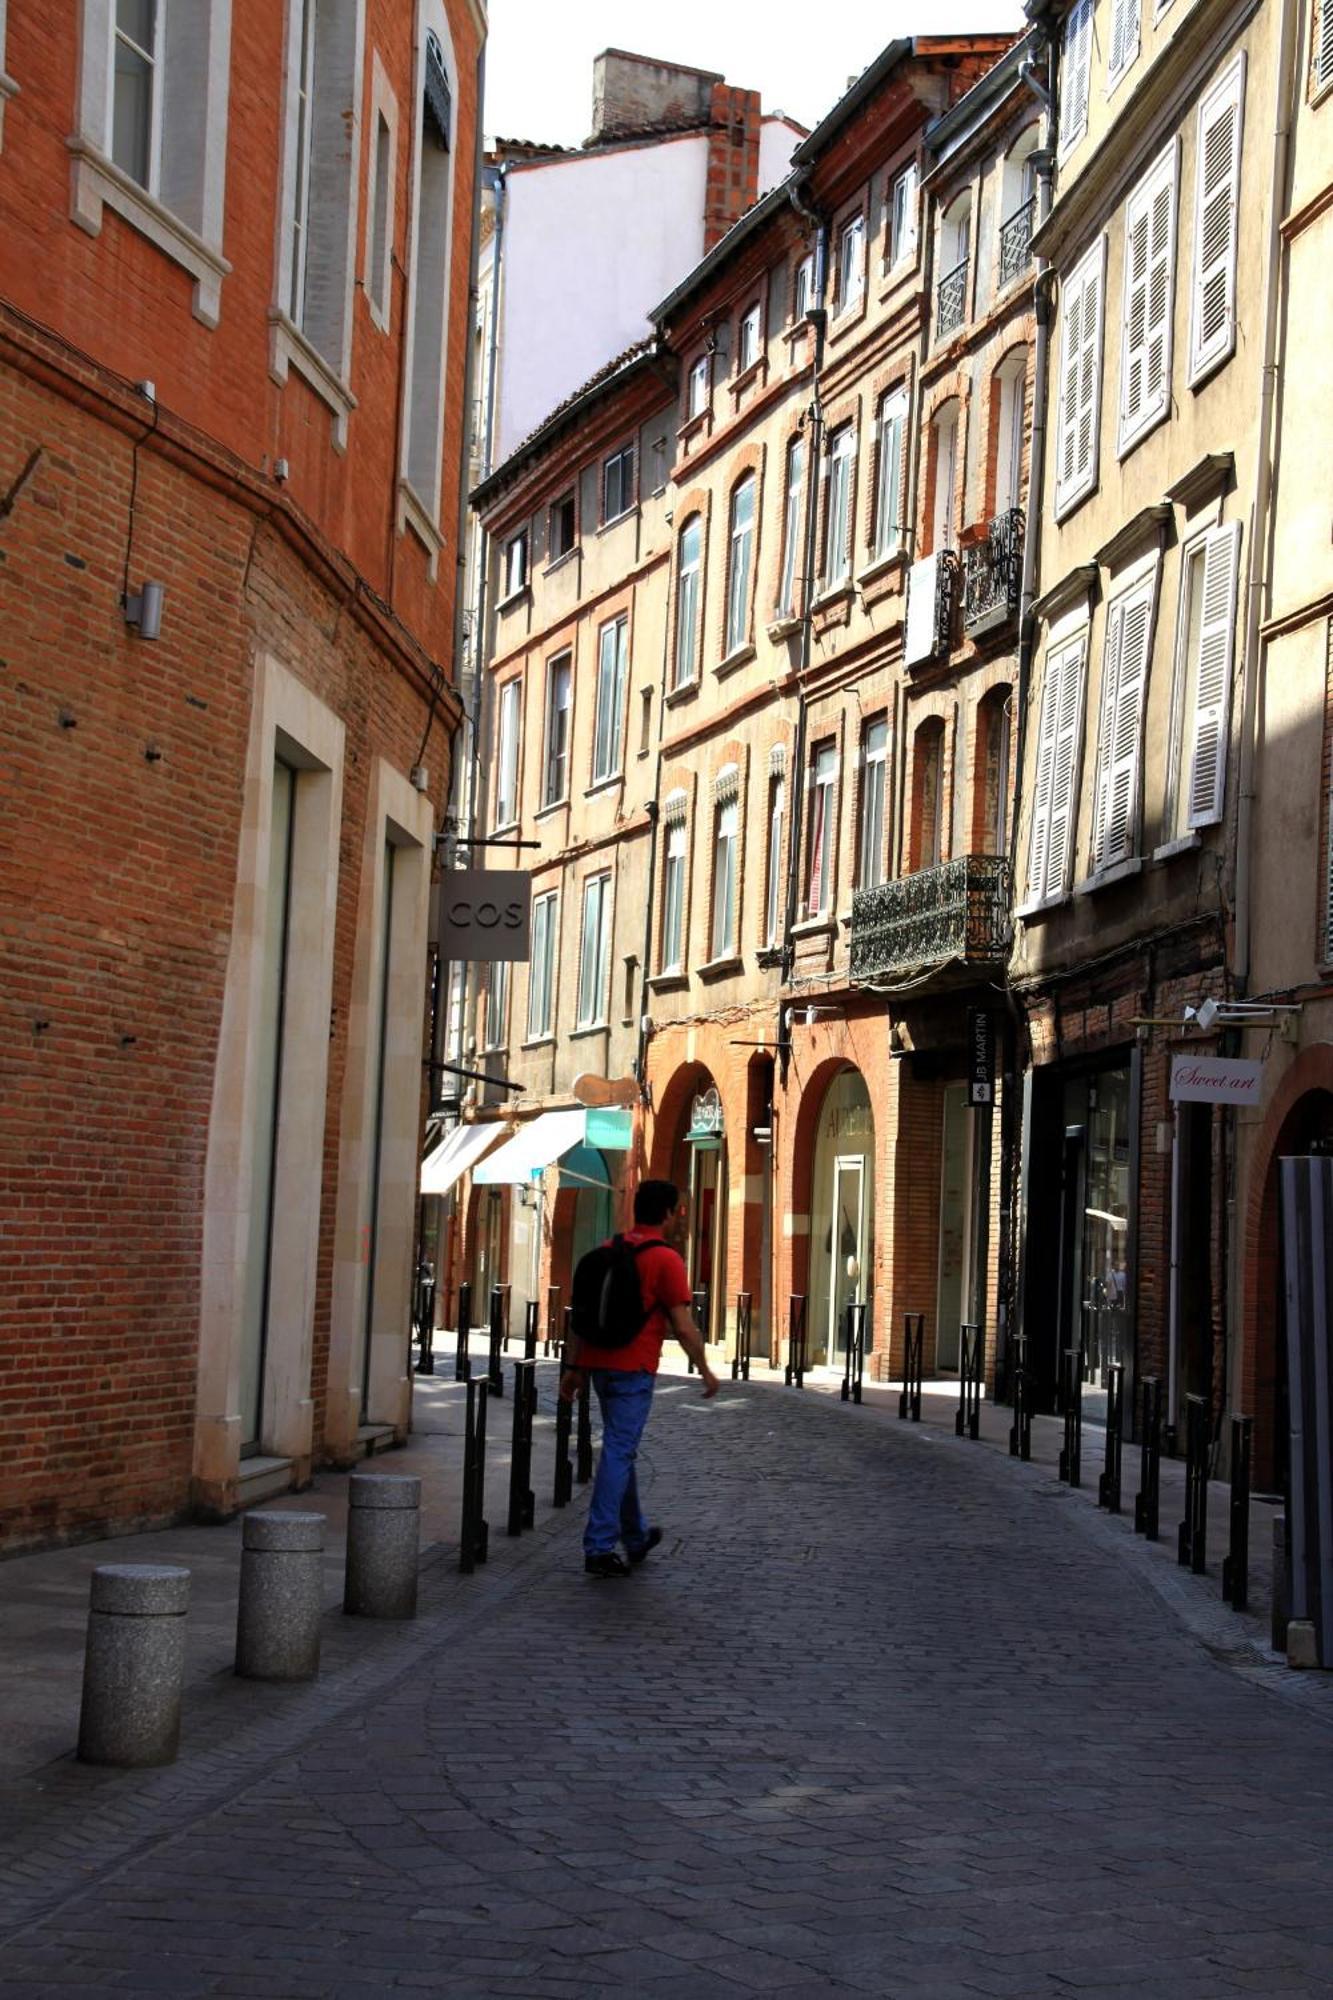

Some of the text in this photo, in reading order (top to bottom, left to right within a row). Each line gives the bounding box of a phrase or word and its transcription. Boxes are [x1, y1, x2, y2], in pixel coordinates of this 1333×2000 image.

[448, 902, 523, 928] COS
[976, 1014, 987, 1081] JB MARTIN
[1174, 1064, 1256, 1089] Sweet art
